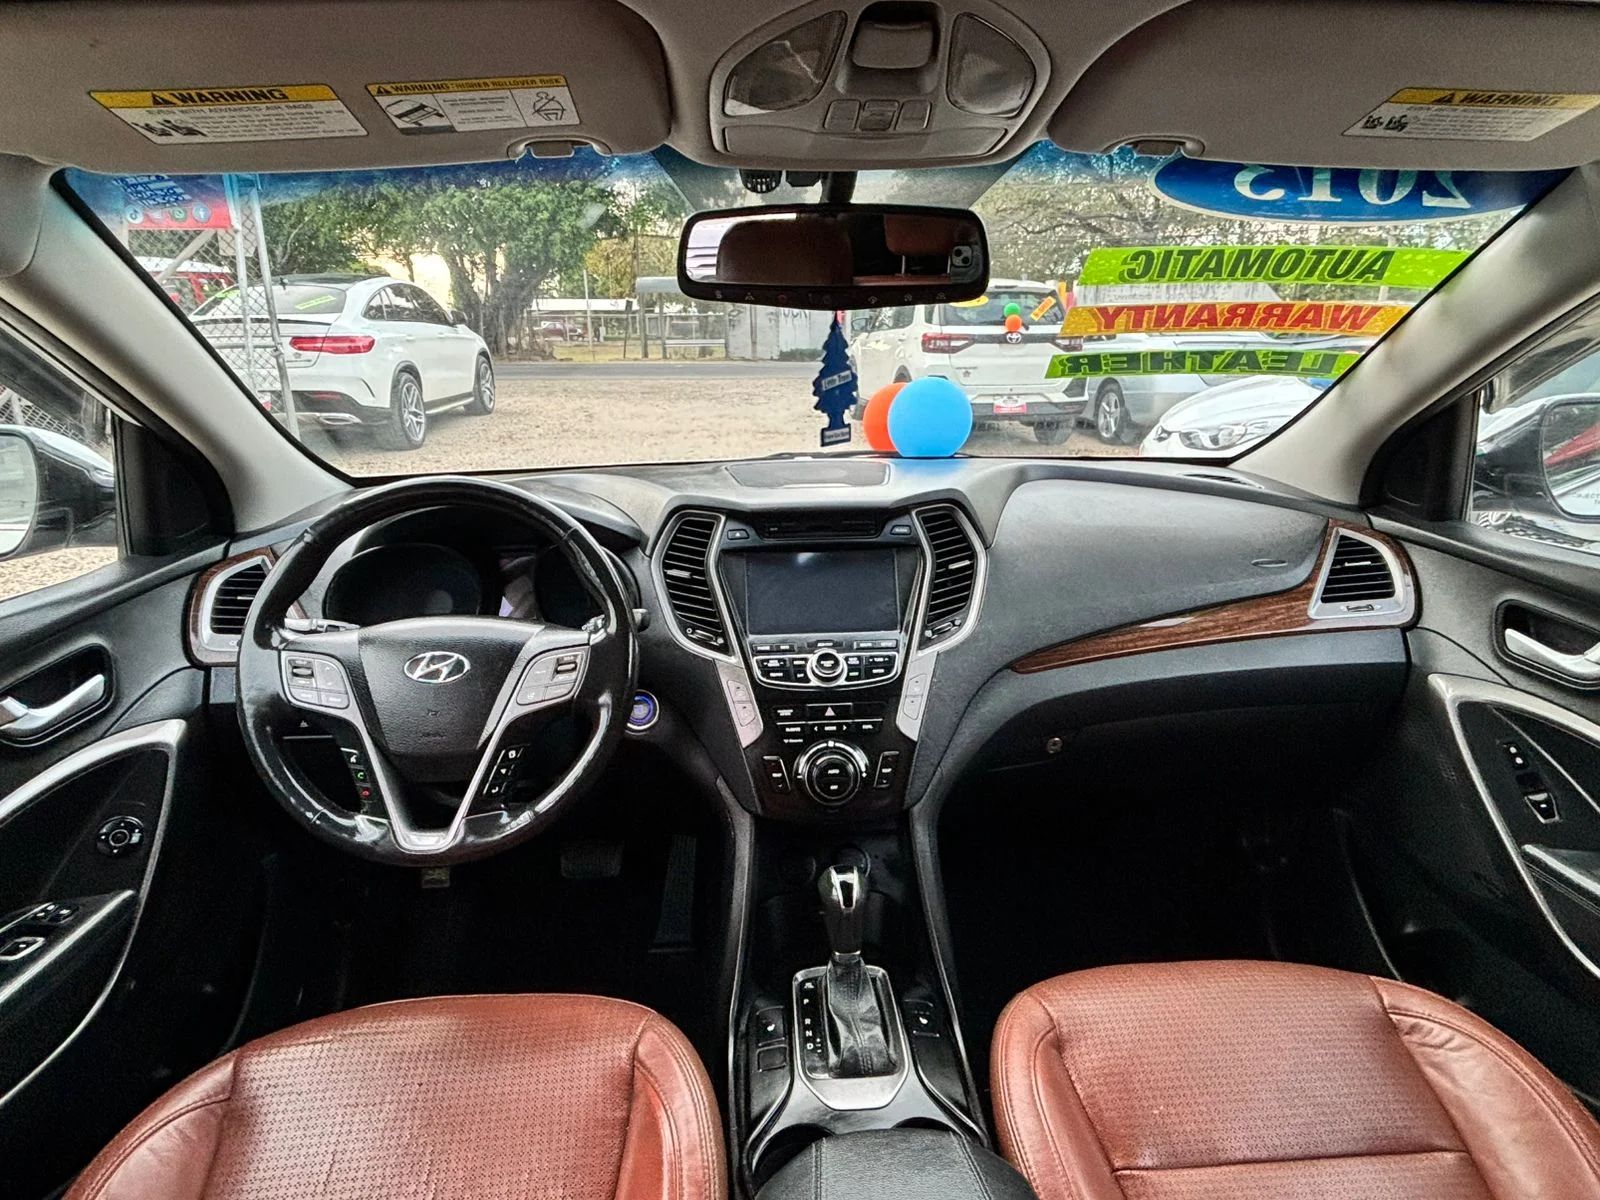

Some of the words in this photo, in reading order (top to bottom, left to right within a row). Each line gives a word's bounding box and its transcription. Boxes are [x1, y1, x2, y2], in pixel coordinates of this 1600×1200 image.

[491, 79, 538, 88] ROLLOVER
[170, 87, 289, 105] WARNING
[1458, 91, 1564, 107] WARNING
